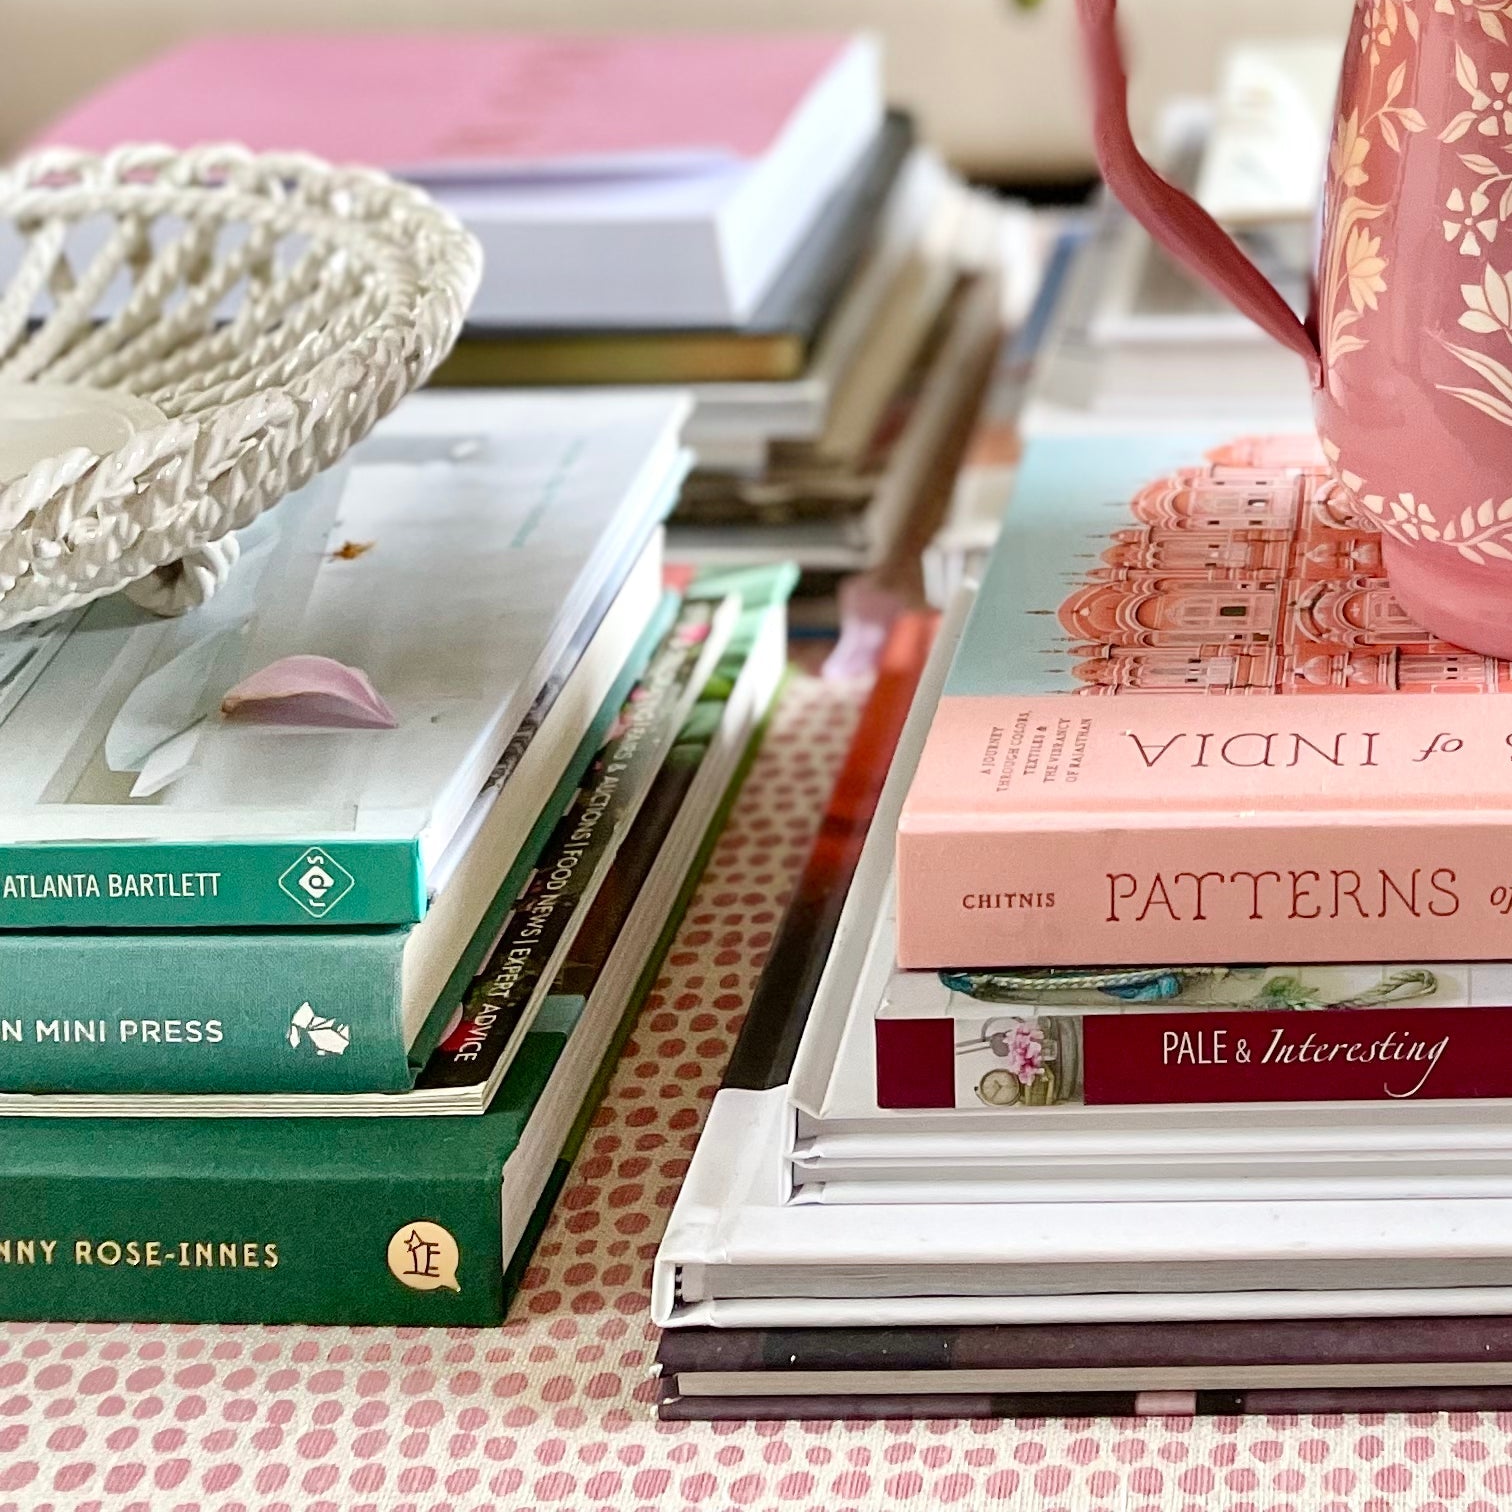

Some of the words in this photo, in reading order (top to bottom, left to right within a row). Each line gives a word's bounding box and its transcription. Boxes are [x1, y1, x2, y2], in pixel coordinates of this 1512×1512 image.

[982, 726, 1004, 767] JOURNEY
[996, 747, 1020, 792] THROUGH
[1011, 710, 1033, 746] COLORS,
[1023, 734, 1046, 776] TEXTILES
[1049, 717, 1071, 763] VIBRANCY
[1069, 718, 1093, 769] RAJASTHAN
[1126, 731, 1381, 768] INDIA
[1411, 731, 1465, 763] of
[1043, 765, 1058, 784] THE
[1065, 770, 1079, 783] OF
[570, 775, 620, 842] AUCTIONS
[2, 873, 101, 899] ATLANTA
[107, 872, 222, 898] BARTLETT
[546, 848, 583, 892] FOOD
[520, 893, 556, 938] NEWS
[962, 892, 1055, 909] CHITNIS
[1105, 866, 1460, 923] PATTERNS
[487, 946, 532, 999] EXPERT
[35, 1019, 106, 1043] MINI
[119, 1019, 224, 1044] PRESS
[453, 1002, 502, 1064] ADVICE
[1162, 1029, 1228, 1065] PALE
[1235, 1037, 1252, 1064] &
[1260, 1027, 1450, 1098] Interesting
[74, 1240, 280, 1269] ROSE-INNES
